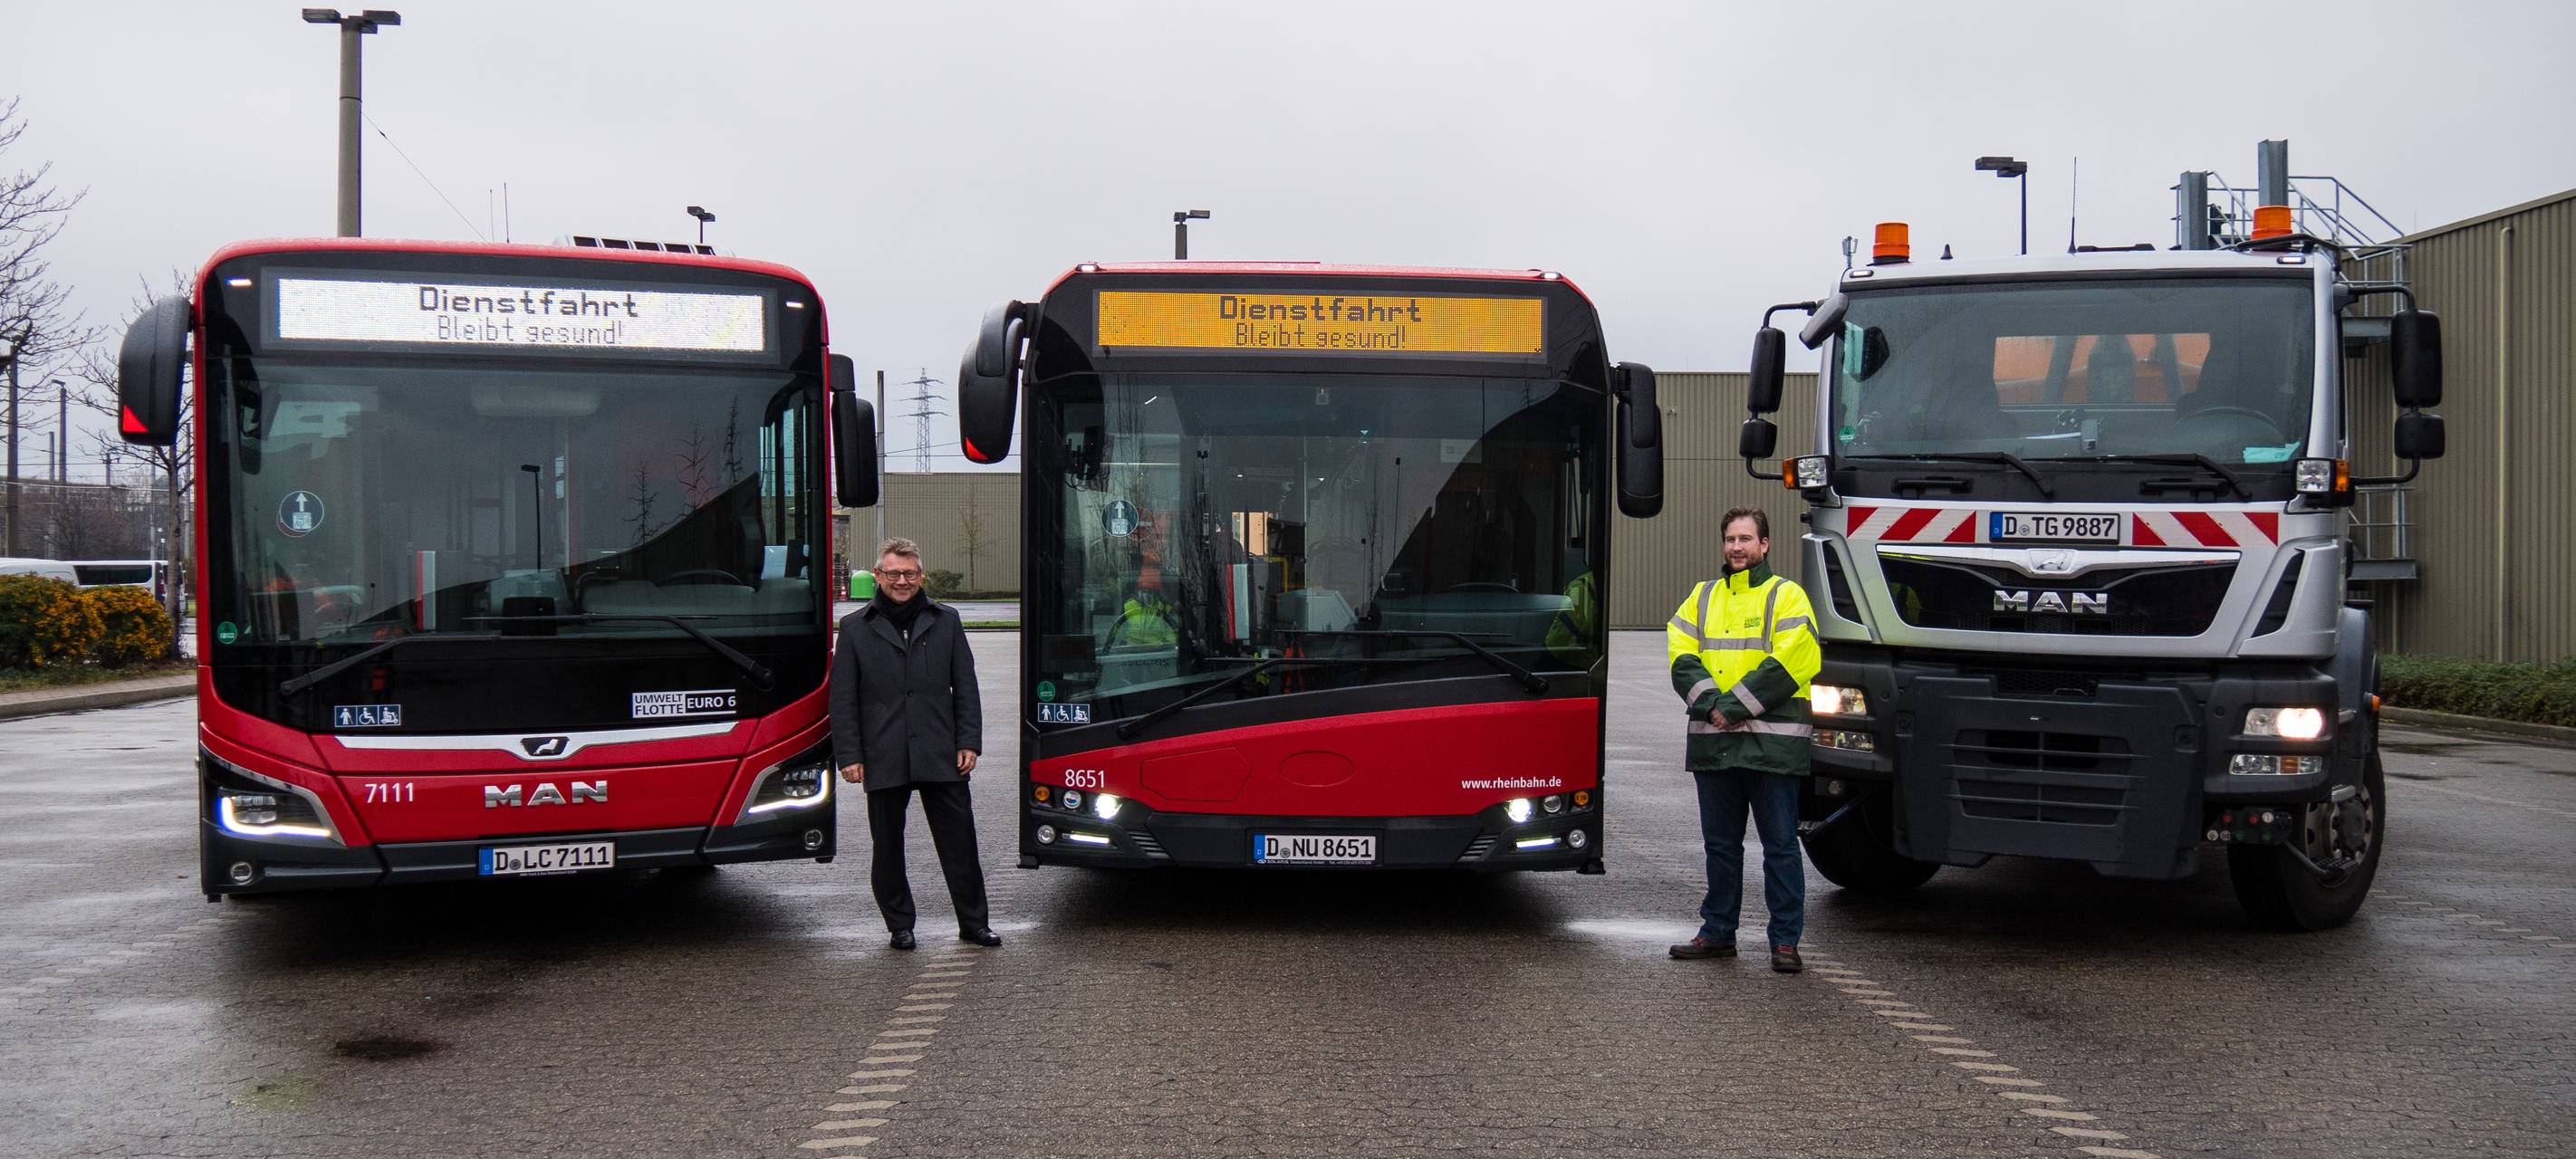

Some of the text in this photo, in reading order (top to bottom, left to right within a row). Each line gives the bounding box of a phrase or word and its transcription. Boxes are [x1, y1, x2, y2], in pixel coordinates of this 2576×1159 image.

[419, 285, 638, 317] Dienstfahrt
[1220, 295, 1421, 322] Dienstfahrt
[437, 314, 623, 345] Bleibt gesund!
[1235, 321, 1406, 349] Bleibt gesund!
[2004, 516, 2018, 536] D
[2031, 516, 2059, 536] TG
[2062, 517, 2116, 537] 9887
[1994, 589, 2109, 614] MAN
[634, 694, 683, 704] UMWELT
[634, 704, 684, 716] FLOTTE
[687, 695, 736, 709] EURO 6
[1064, 769, 1105, 789] 8651
[1461, 775, 1562, 790] www.rheinbahn.de
[364, 781, 415, 804] 7111
[484, 780, 609, 809] MAN
[495, 851, 509, 871] D
[524, 848, 553, 869] LC
[556, 846, 610, 867] 7111
[1266, 838, 1280, 857] D
[1292, 838, 1319, 857] NU
[1322, 838, 1372, 858] 8651
